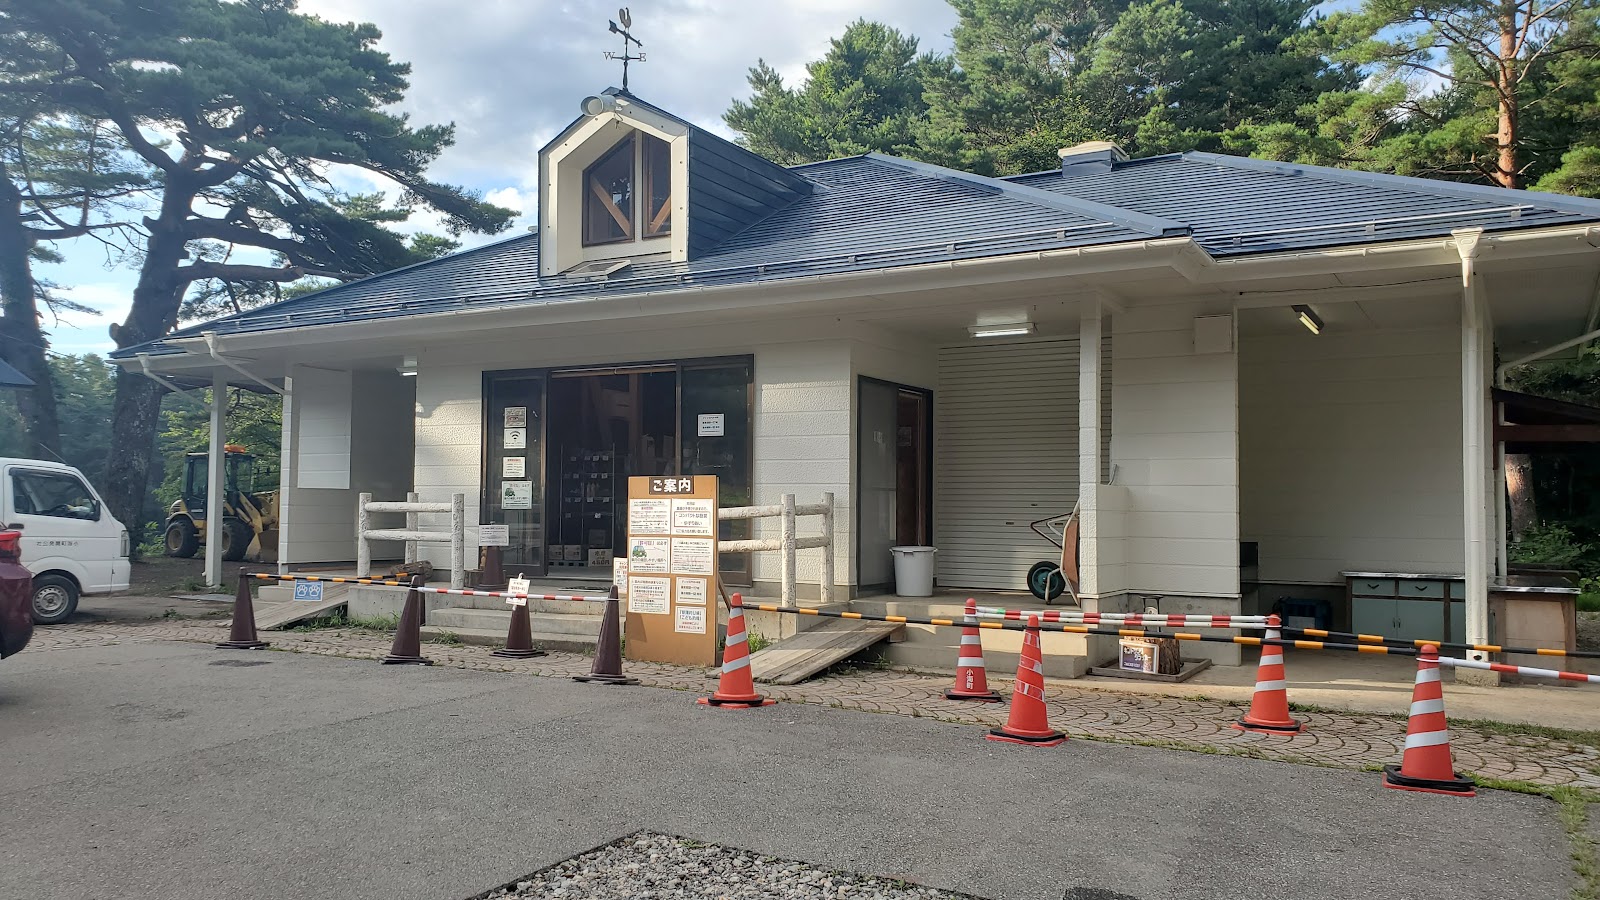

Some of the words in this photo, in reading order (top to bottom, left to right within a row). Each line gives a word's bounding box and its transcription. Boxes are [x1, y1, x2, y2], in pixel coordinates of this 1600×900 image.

[603, 51, 615, 60] W
[638, 52, 647, 62] E
[653, 477, 691, 492] ご案内
